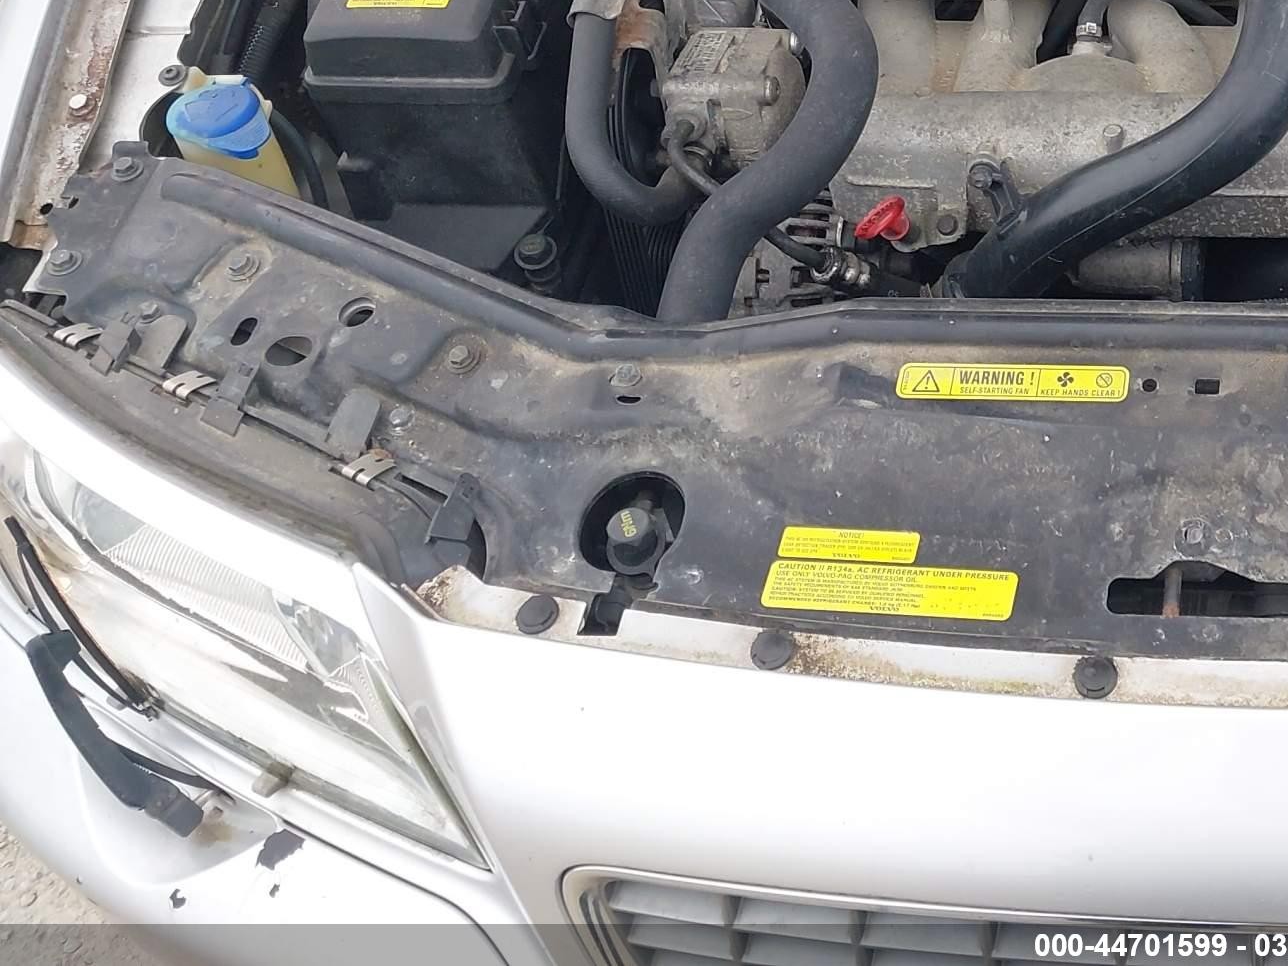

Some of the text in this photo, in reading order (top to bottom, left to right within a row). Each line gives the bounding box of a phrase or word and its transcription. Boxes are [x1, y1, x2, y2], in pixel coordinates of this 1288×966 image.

[960, 370, 1025, 386] WARNING
[1015, 387, 1030, 395] FAN
[778, 562, 816, 570] CAUTION
[871, 567, 929, 576] REFRIGERANT
[932, 570, 962, 578] UNDER
[964, 572, 1008, 580] PRESSURE
